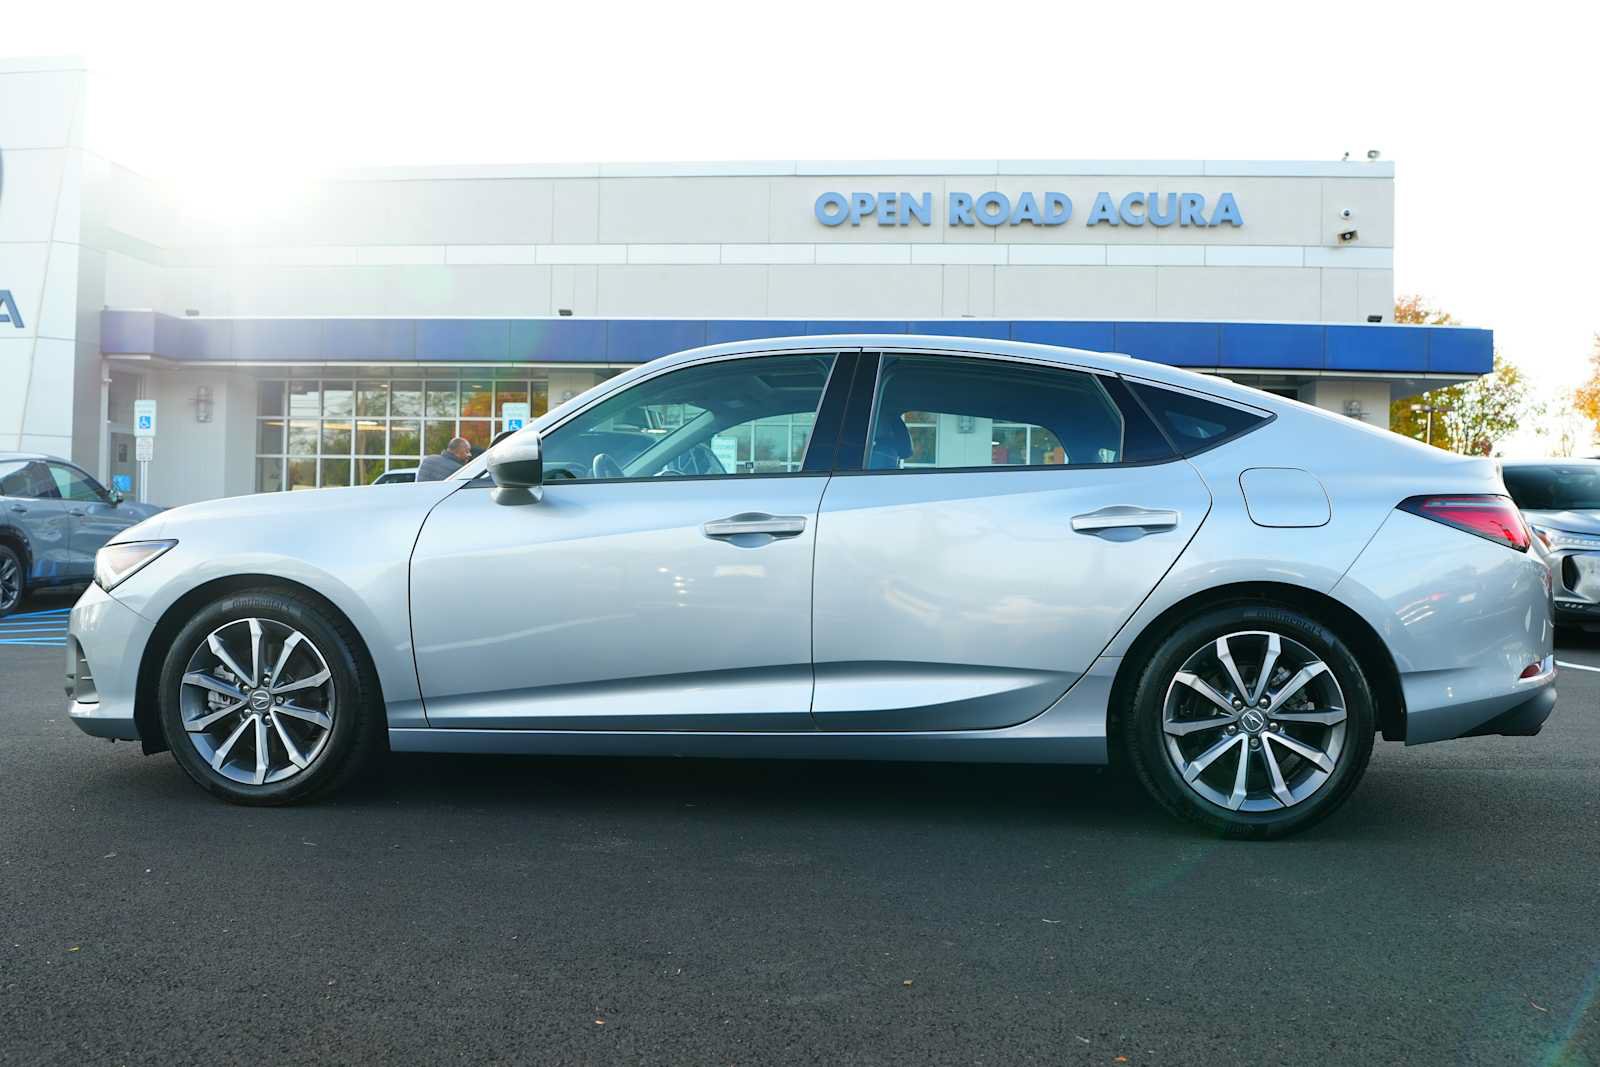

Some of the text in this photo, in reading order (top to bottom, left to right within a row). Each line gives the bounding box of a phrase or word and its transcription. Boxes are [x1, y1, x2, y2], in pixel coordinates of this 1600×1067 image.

[815, 191, 1244, 227] OPEN ROAD ACURA
